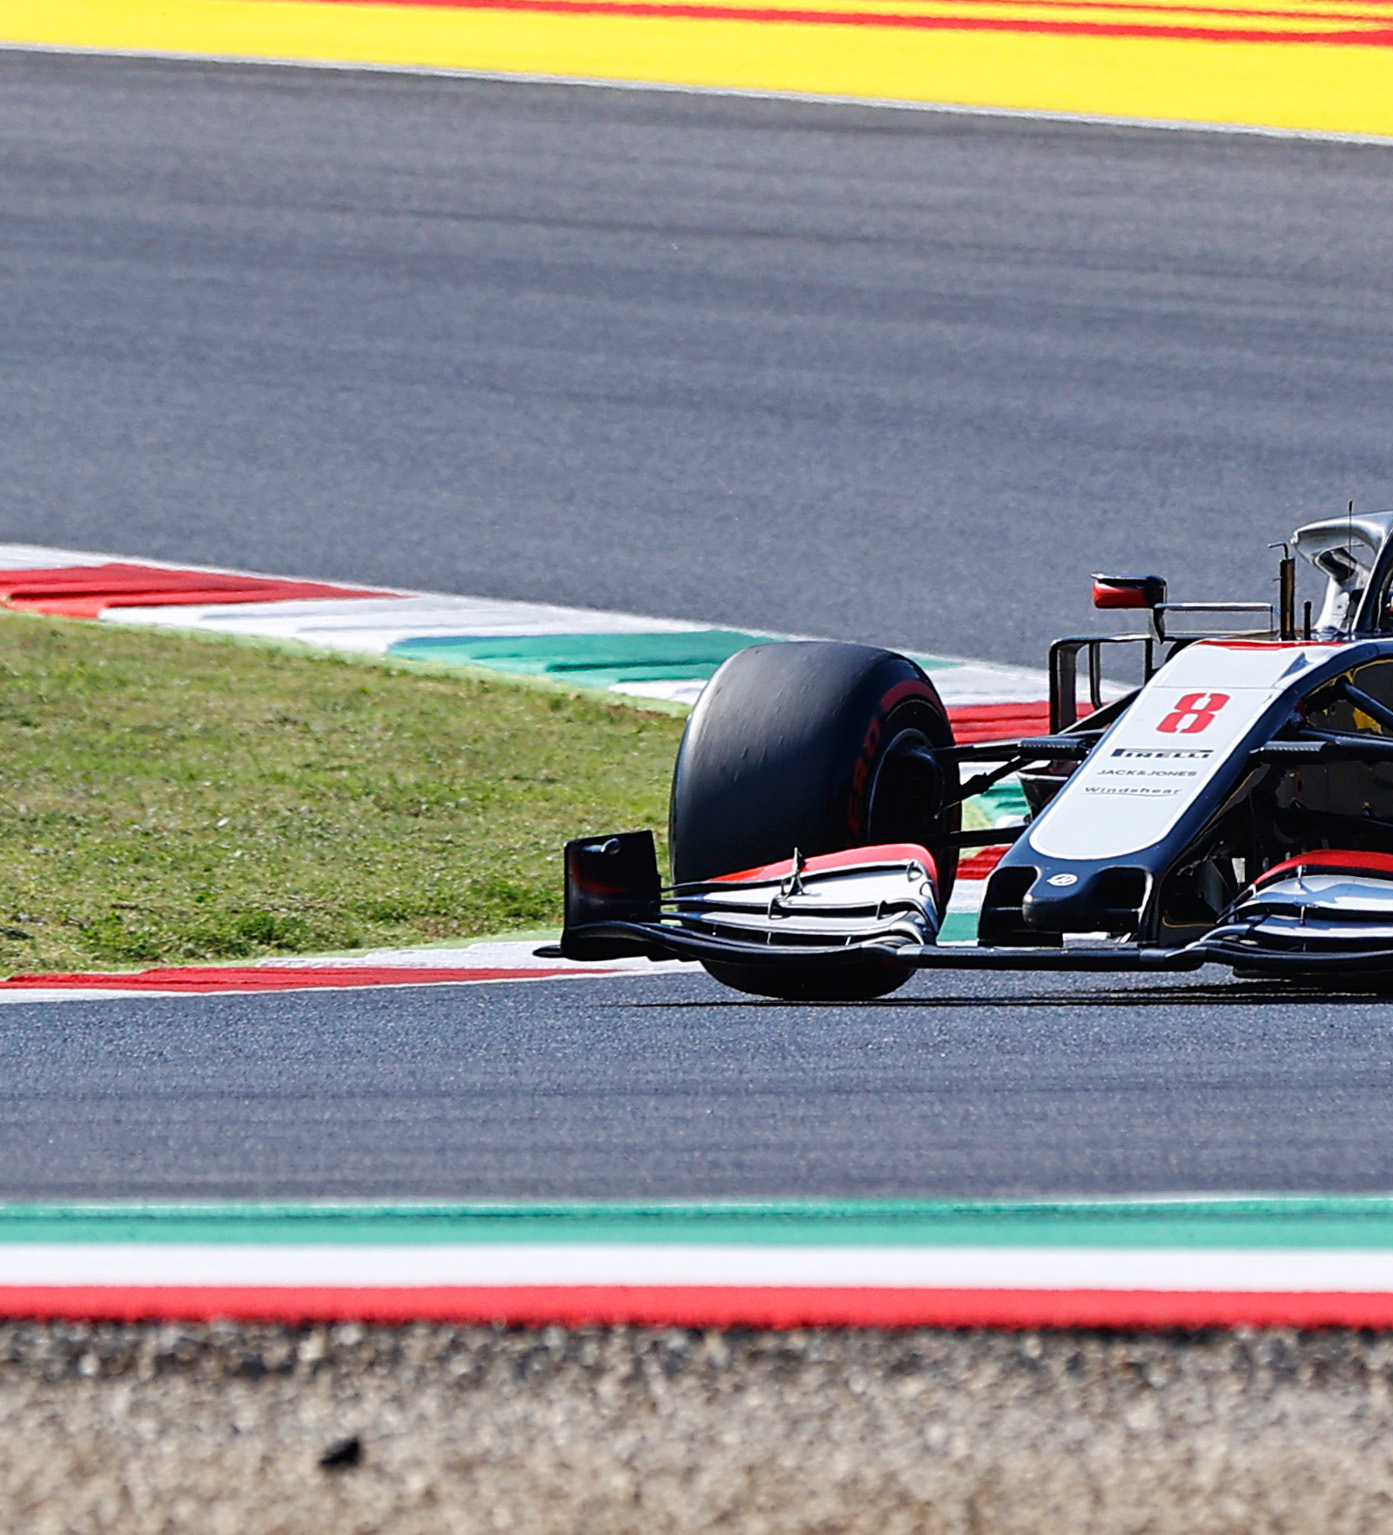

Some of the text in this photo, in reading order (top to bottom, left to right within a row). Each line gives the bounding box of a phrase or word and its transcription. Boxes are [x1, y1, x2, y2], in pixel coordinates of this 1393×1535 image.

[1155, 692, 1231, 734] 8
[1109, 747, 1214, 759] PIRELLI
[1096, 769, 1199, 777] JACK&JONES
[1083, 785, 1183, 796] Windshear
